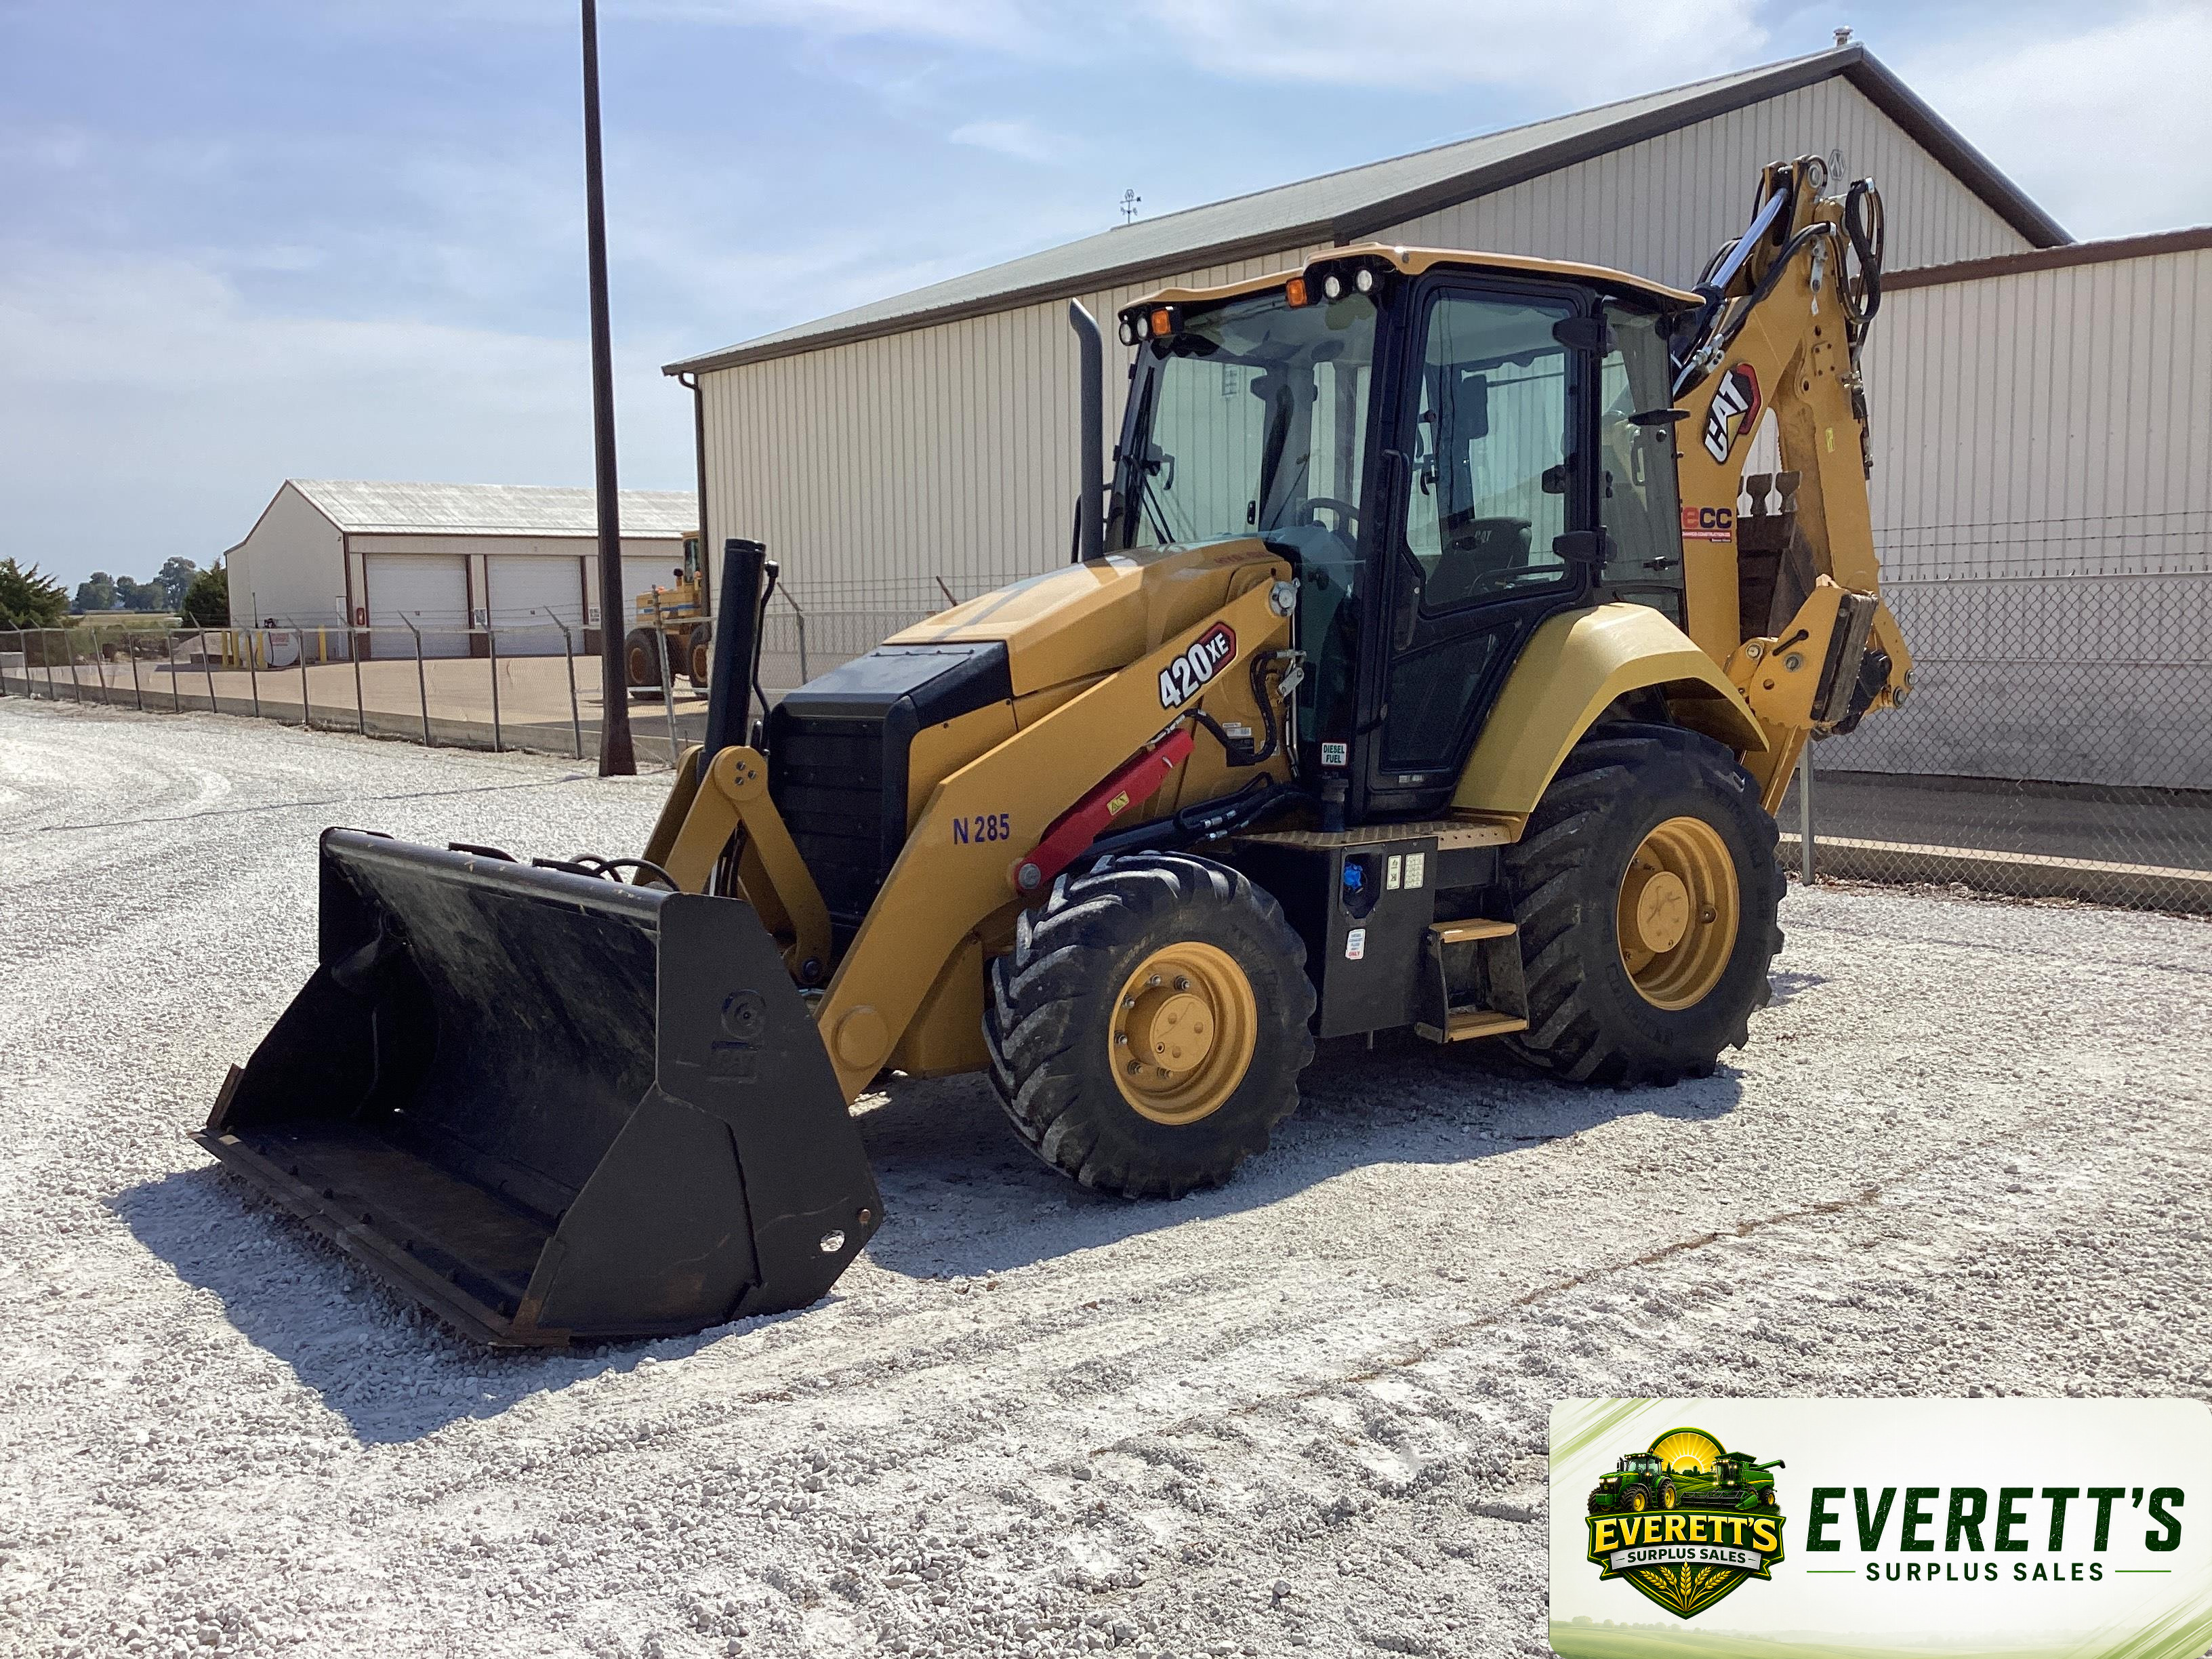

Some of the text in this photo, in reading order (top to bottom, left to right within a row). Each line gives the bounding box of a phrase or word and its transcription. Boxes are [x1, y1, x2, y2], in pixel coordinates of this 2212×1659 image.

[1704, 369, 1749, 462] CAT
[1324, 744, 1345, 754] DIESEL
[1326, 754, 1342, 763] FUEL
[954, 813, 1010, 845] N 285
